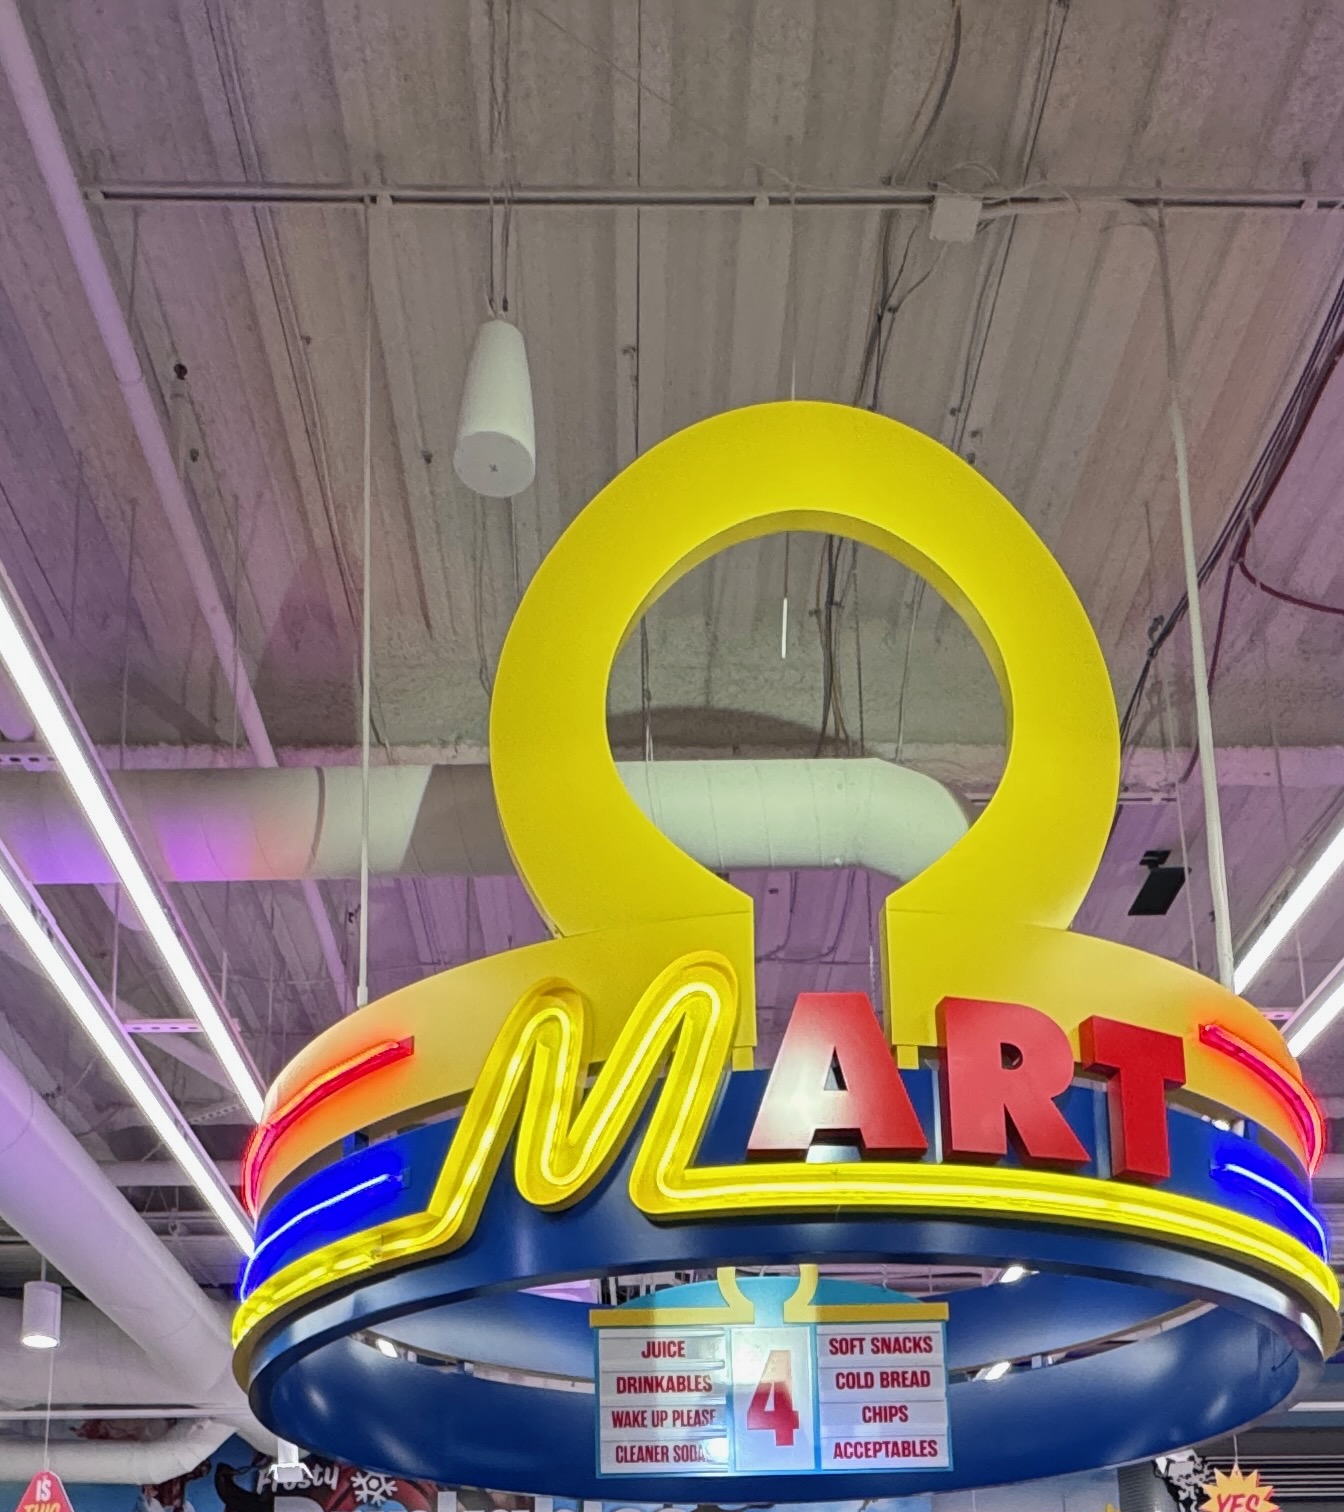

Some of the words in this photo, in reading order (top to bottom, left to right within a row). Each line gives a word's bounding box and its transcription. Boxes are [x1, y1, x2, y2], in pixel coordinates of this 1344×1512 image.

[426, 948, 1188, 1220] MART
[641, 1340, 686, 1359] JUICE
[828, 1338, 866, 1356] SOFT
[870, 1336, 934, 1354] SNACKS
[616, 1373, 713, 1395] DRINKABLES
[835, 1371, 875, 1389] COLD
[879, 1370, 931, 1388] BREAD
[746, 1349, 800, 1447] 4
[611, 1410, 648, 1428] WAKE
[651, 1409, 669, 1427] UP
[672, 1408, 717, 1427] PLEASE
[861, 1405, 909, 1424] CHIPS
[615, 1445, 669, 1464] CLEANER
[833, 1440, 938, 1459] ACCEPTABLES
[36, 1476, 51, 1500] IS
